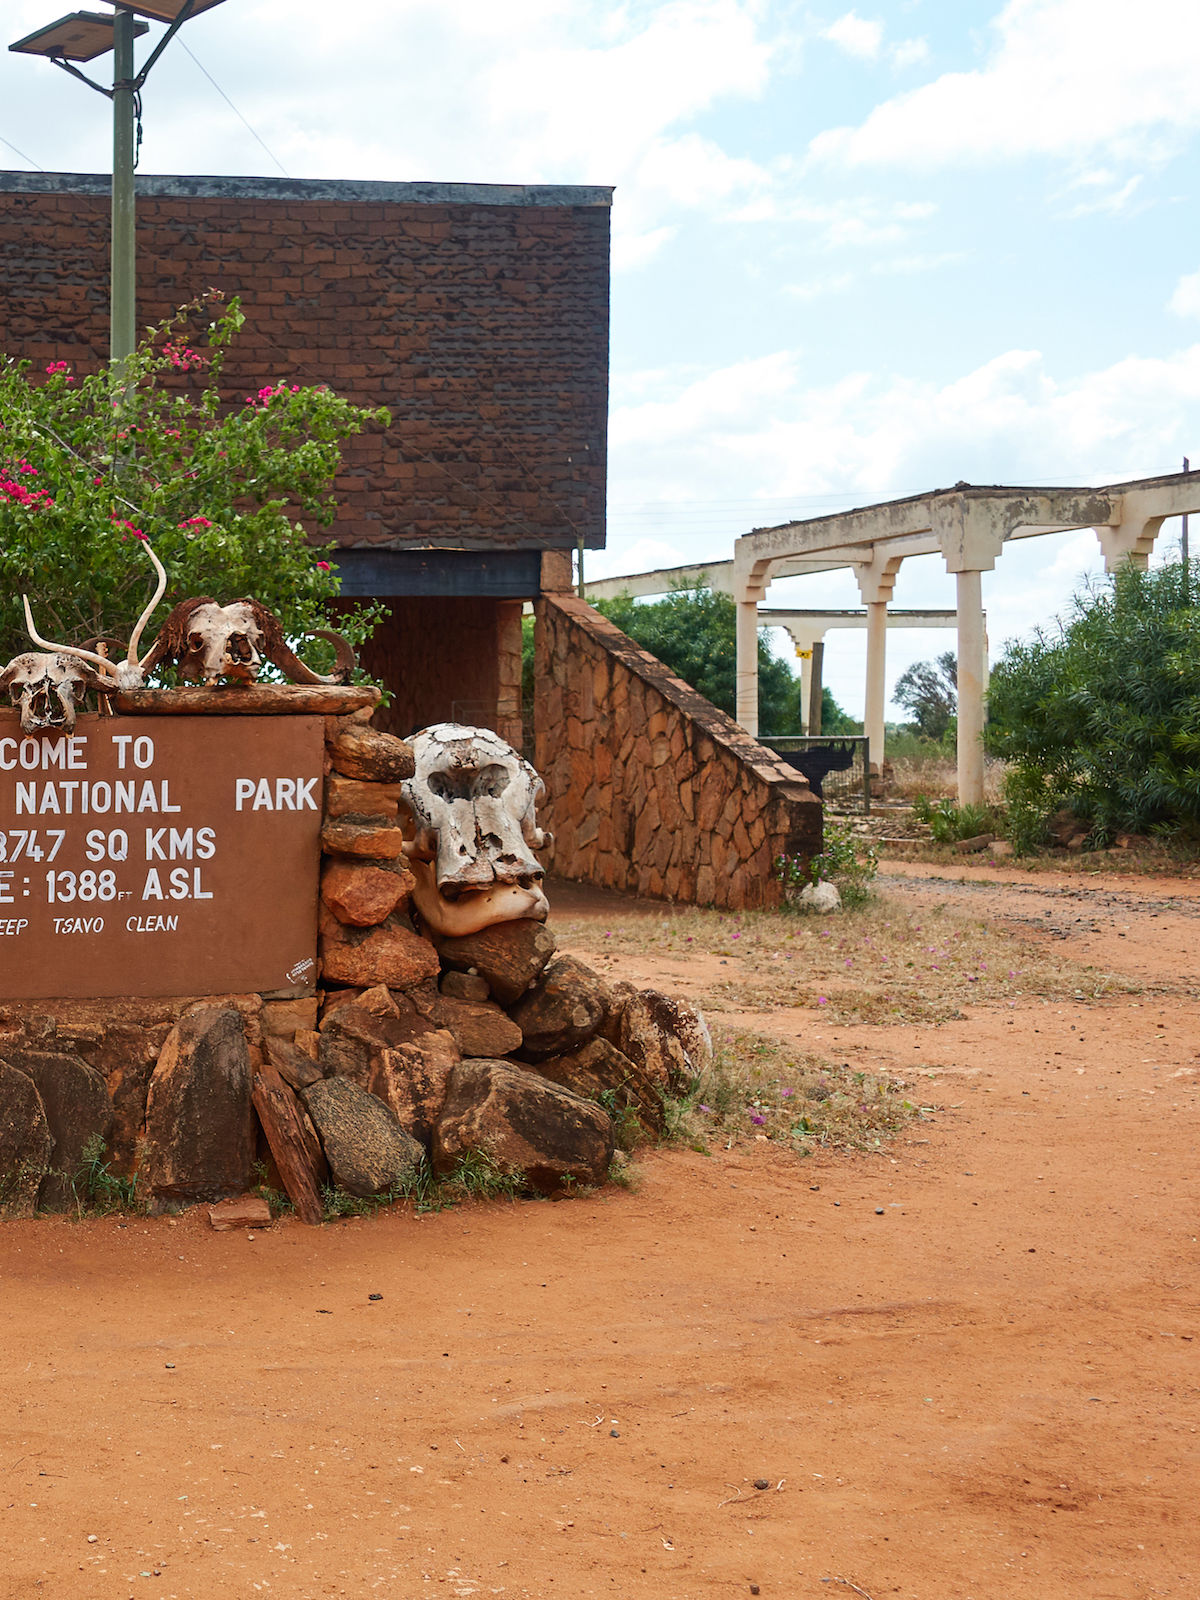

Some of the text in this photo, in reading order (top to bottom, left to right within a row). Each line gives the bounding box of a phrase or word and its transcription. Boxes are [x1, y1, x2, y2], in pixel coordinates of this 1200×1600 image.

[111, 735, 155, 769] TO
[15, 779, 182, 815] NATIONAL
[235, 777, 319, 812] PARK
[85, 828, 129, 862] SQ
[145, 826, 217, 861] KMS
[141, 867, 214, 901] A.S.L
[52, 916, 105, 934] TSAVO
[125, 914, 179, 932] CLEAN
